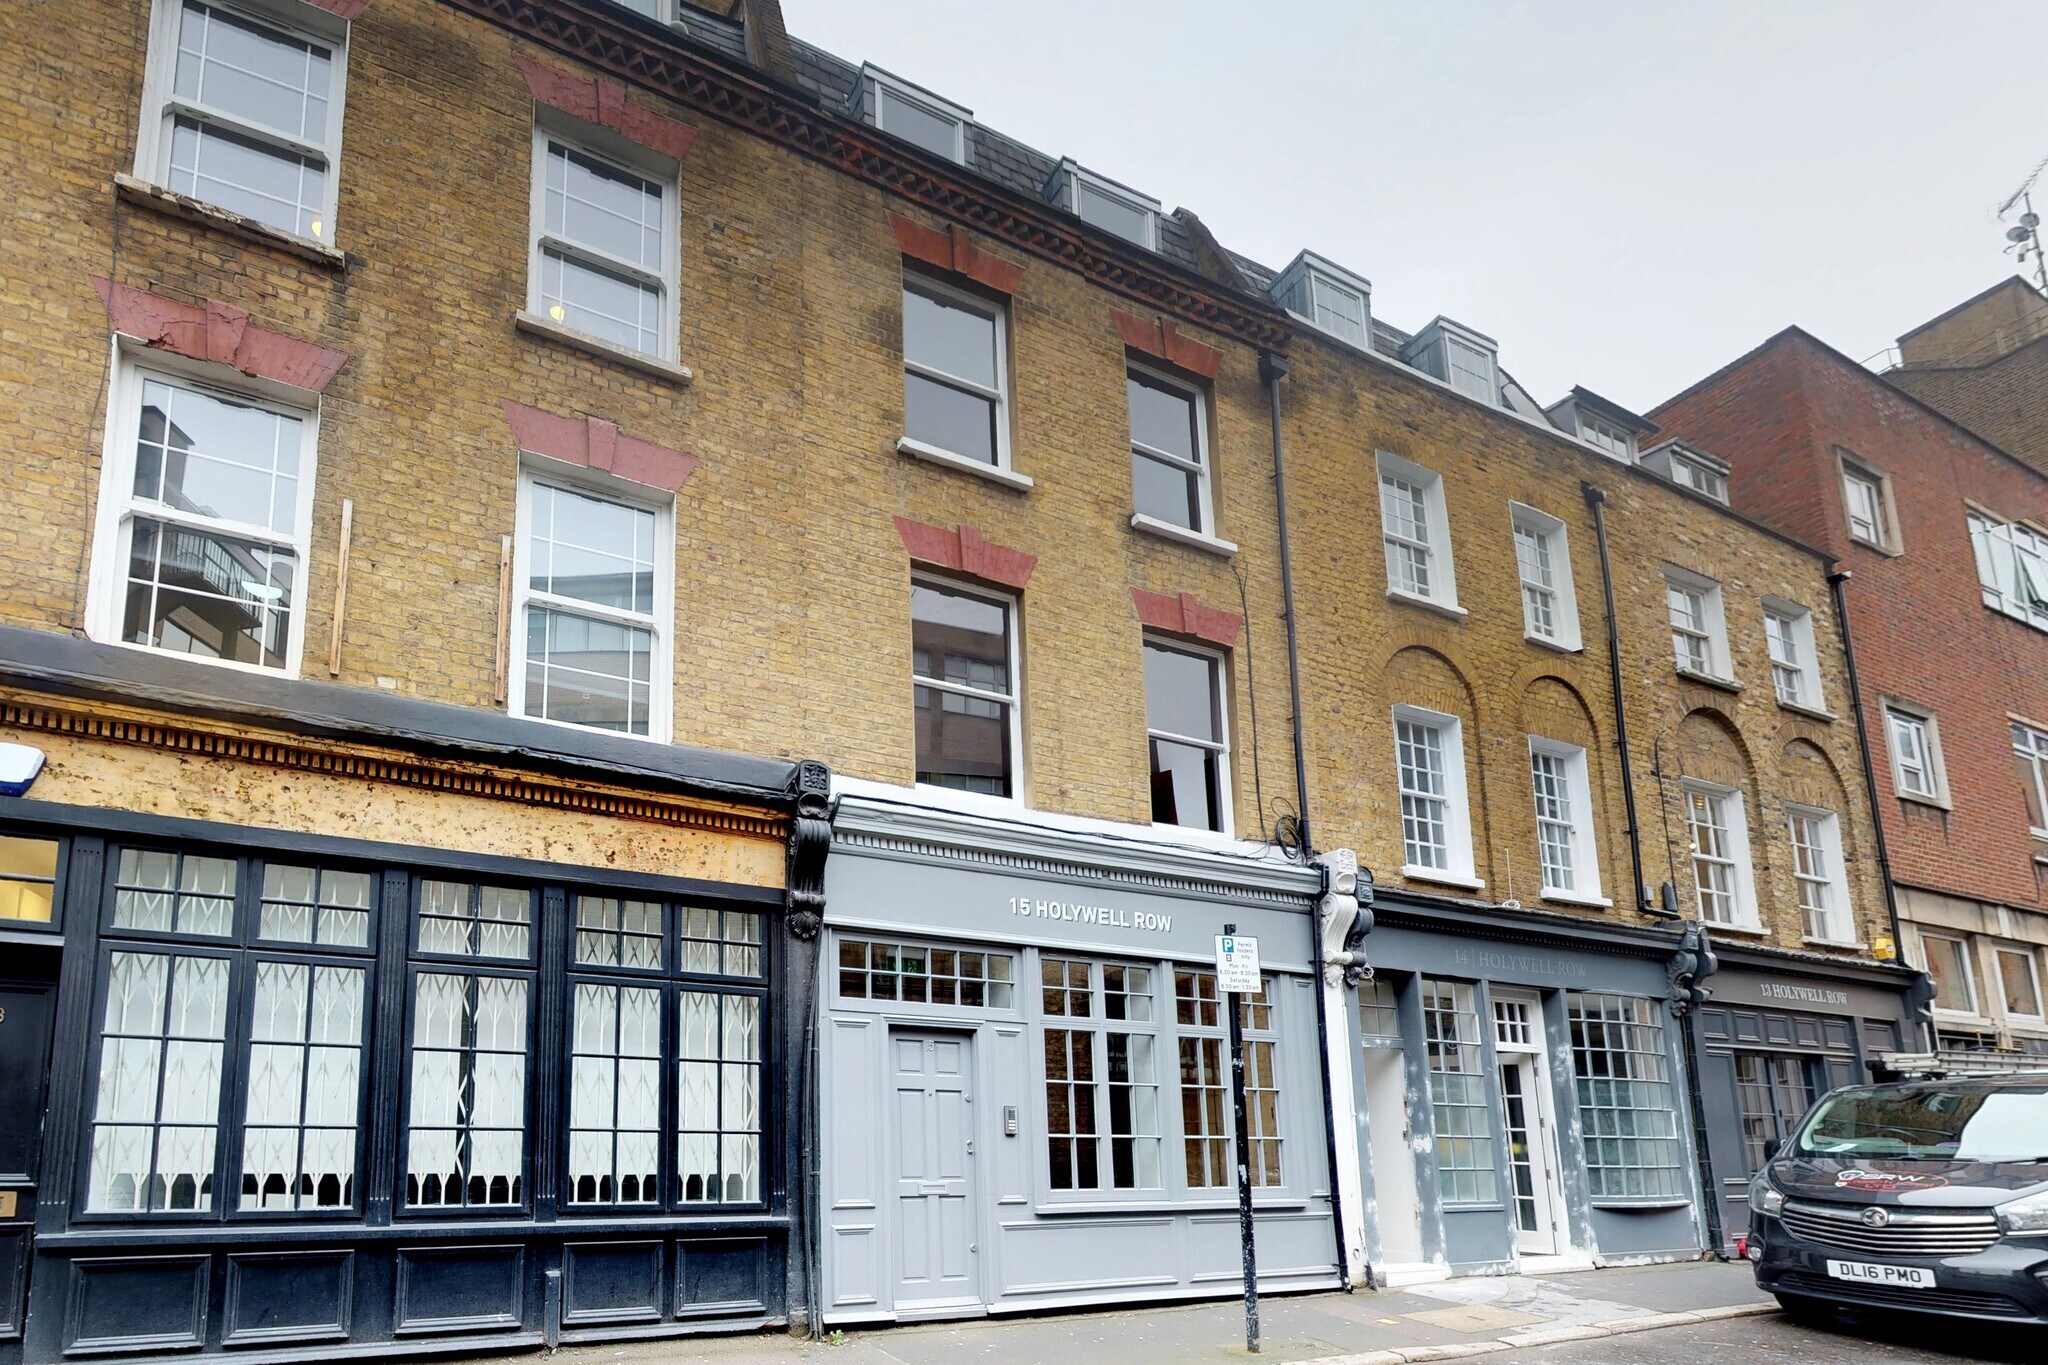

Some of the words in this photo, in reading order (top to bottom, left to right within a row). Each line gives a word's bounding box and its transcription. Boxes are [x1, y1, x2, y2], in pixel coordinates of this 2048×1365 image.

[1009, 897, 1031, 916] 15
[1036, 900, 1131, 928] HOLYWELL
[1134, 911, 1172, 932] ROW
[1223, 938, 1233, 952] P
[1455, 949, 1470, 965] 14
[1479, 951, 1555, 975] HOLYWELL
[1558, 960, 1587, 977] ROW
[1760, 984, 1771, 997] 13
[1772, 984, 1827, 1003] HOLYWELL
[1825, 990, 1848, 1005] ROW
[1839, 1263, 1879, 1279] DL16
[1884, 1267, 1922, 1283] PMO
